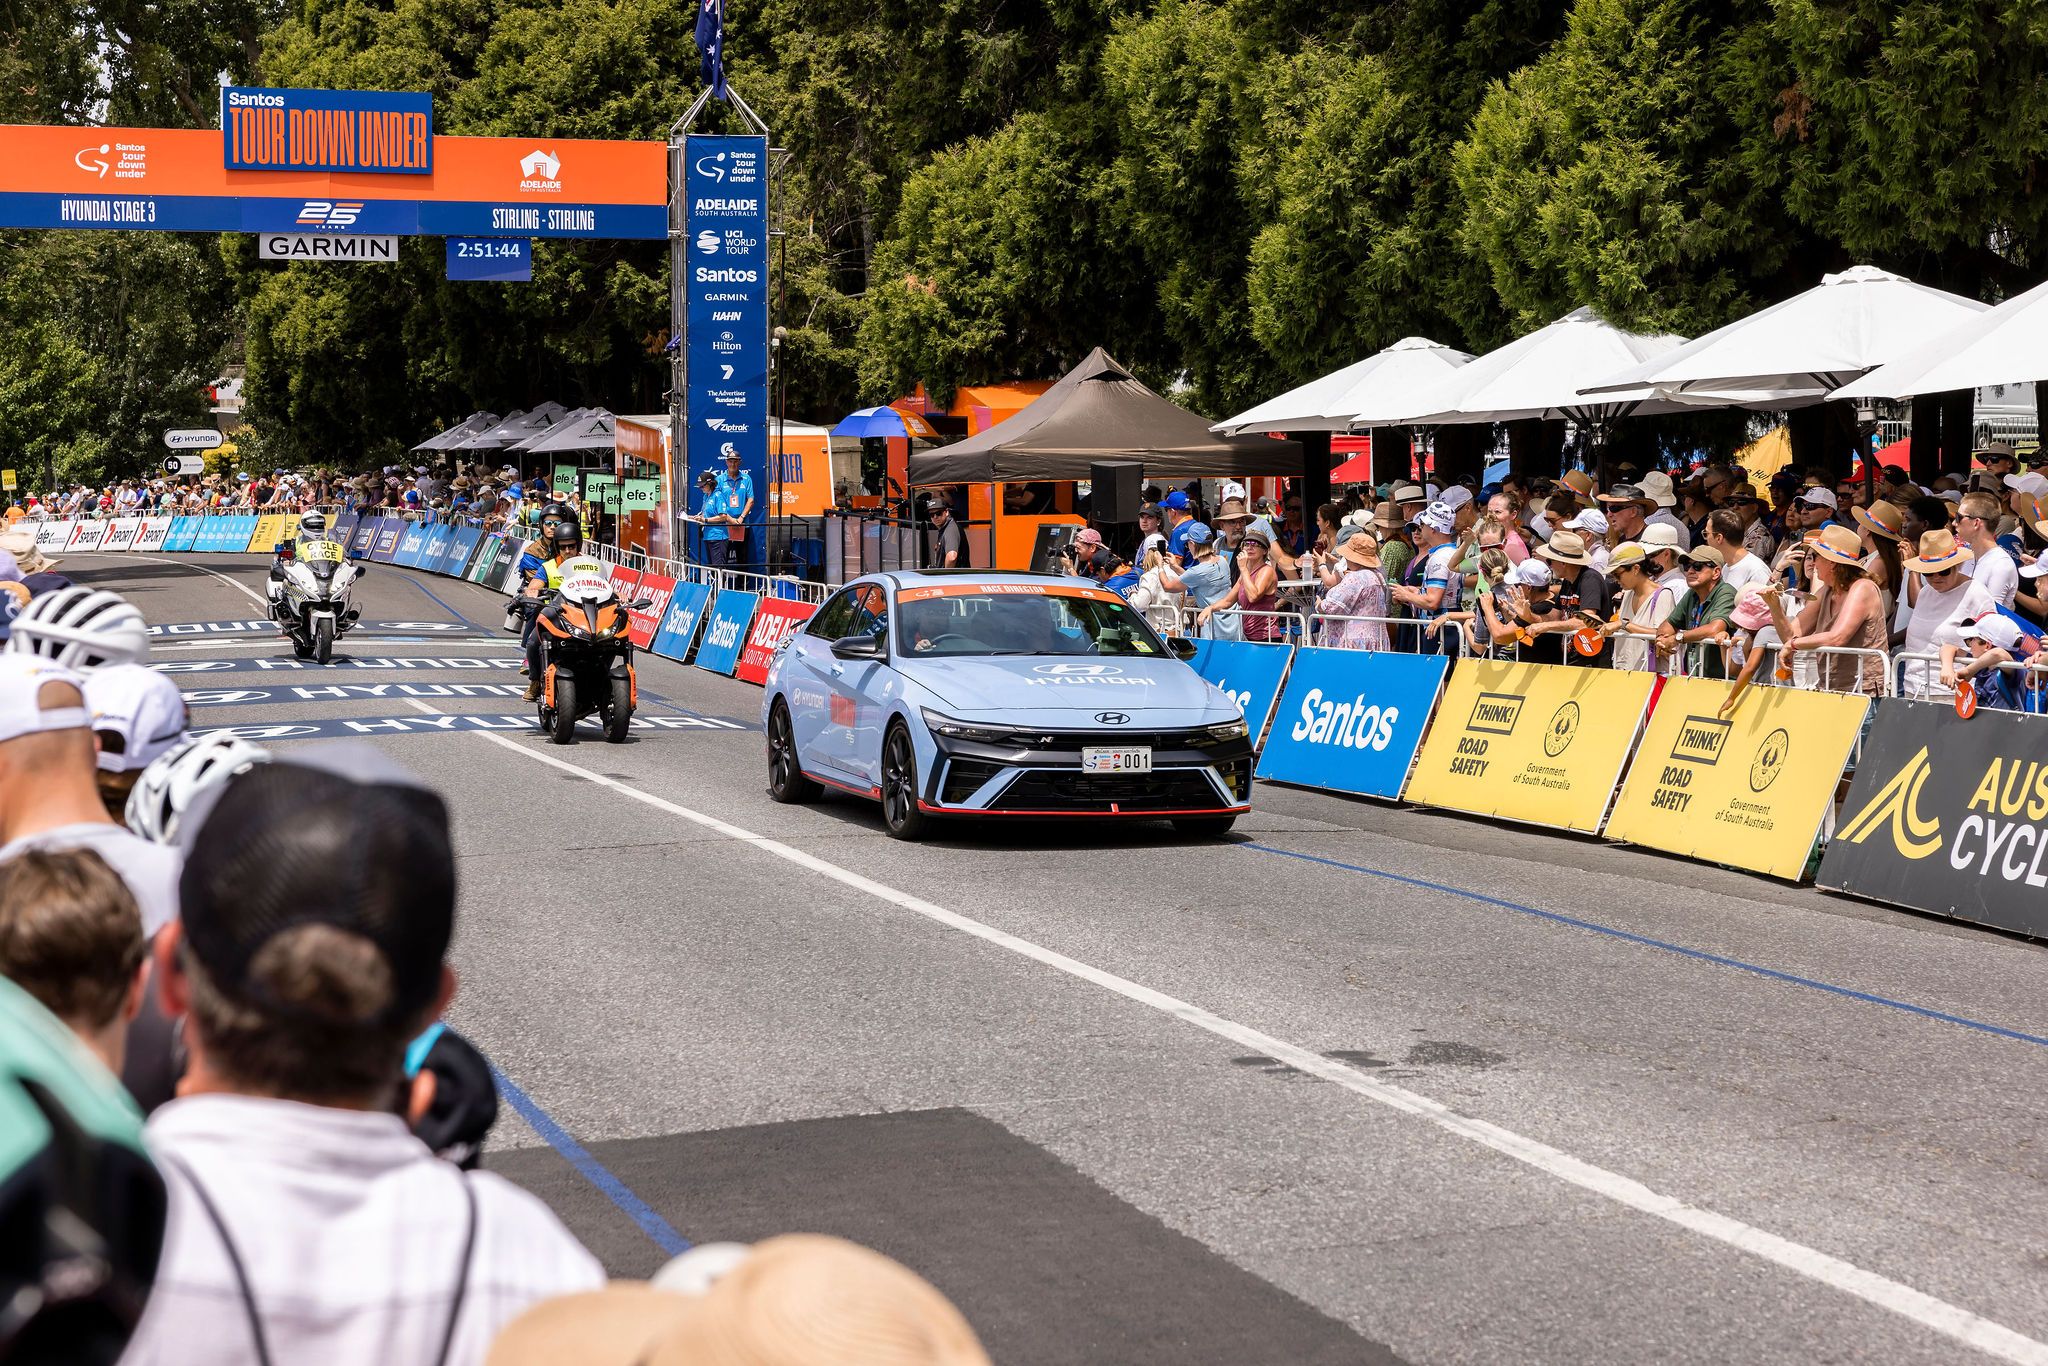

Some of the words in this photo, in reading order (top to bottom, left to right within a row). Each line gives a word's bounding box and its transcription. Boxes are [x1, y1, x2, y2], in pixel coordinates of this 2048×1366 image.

[229, 92, 285, 107] Santos
[229, 107, 286, 165] TOUR
[289, 109, 355, 167] DOWN
[358, 111, 428, 168] UNDER
[115, 143, 146, 151] Santos
[122, 152, 146, 160] tour
[730, 151, 756, 159] Santos
[117, 160, 146, 169] down
[731, 166, 756, 174] down
[115, 169, 146, 178] under
[729, 174, 756, 182] under
[519, 180, 561, 189] ADELAIDE
[61, 199, 111, 221] HYUNDAI
[113, 201, 147, 222] STAGE
[148, 201, 156, 222] 3
[695, 198, 758, 211] ADELAIDE
[295, 201, 365, 225] 25
[492, 207, 540, 230] STIRLING
[548, 209, 595, 231] STIRLING
[724, 229, 743, 238] UCI
[268, 236, 391, 258] GARMIN
[457, 242, 521, 258] 2:51:44
[725, 238, 757, 247] WORLD
[725, 246, 750, 255] TOUR
[696, 266, 758, 283] Santos
[704, 293, 748, 302] GARMIN
[711, 311, 742, 321] HAHN
[712, 341, 742, 350] Hilton
[720, 364, 735, 380] 7
[719, 389, 746, 397] Advertiser
[720, 423, 748, 433] Ziptrak
[167, 460, 179, 470] 50
[78, 530, 101, 544] SPORT
[111, 529, 134, 544] SPORT
[143, 528, 165, 544] SPORT
[306, 543, 338, 552] CYCLE
[310, 550, 337, 560] RACE
[573, 564, 594, 572] PHOTO
[575, 579, 608, 590] YAMAHA
[979, 584, 1003, 593] RACE
[1003, 584, 1046, 593] DIRECTOR
[665, 602, 695, 637] Santos
[707, 612, 741, 649] Santos
[743, 647, 765, 667] SOUTH
[1024, 675, 1157, 686] HYUNDAI
[1291, 687, 1400, 752] Santos
[1476, 703, 1516, 724] THINK!
[1456, 736, 1490, 757] ROAD
[1680, 728, 1723, 752] THINK!
[1124, 753, 1148, 769] 001
[1449, 756, 1490, 778] SAFETY
[1526, 762, 1567, 777] Government
[1659, 765, 1693, 788] ROAD
[1512, 773, 1523, 783] of
[1521, 774, 1542, 787] South
[1541, 777, 1571, 791] Australia
[1966, 757, 2048, 821] AUS
[1650, 788, 1693, 813] SAFETY
[1729, 797, 1771, 816] Government
[1715, 810, 1726, 820] of
[1723, 811, 1744, 825] South
[1743, 815, 1774, 831] Australia
[1950, 814, 2048, 888] CYCL
